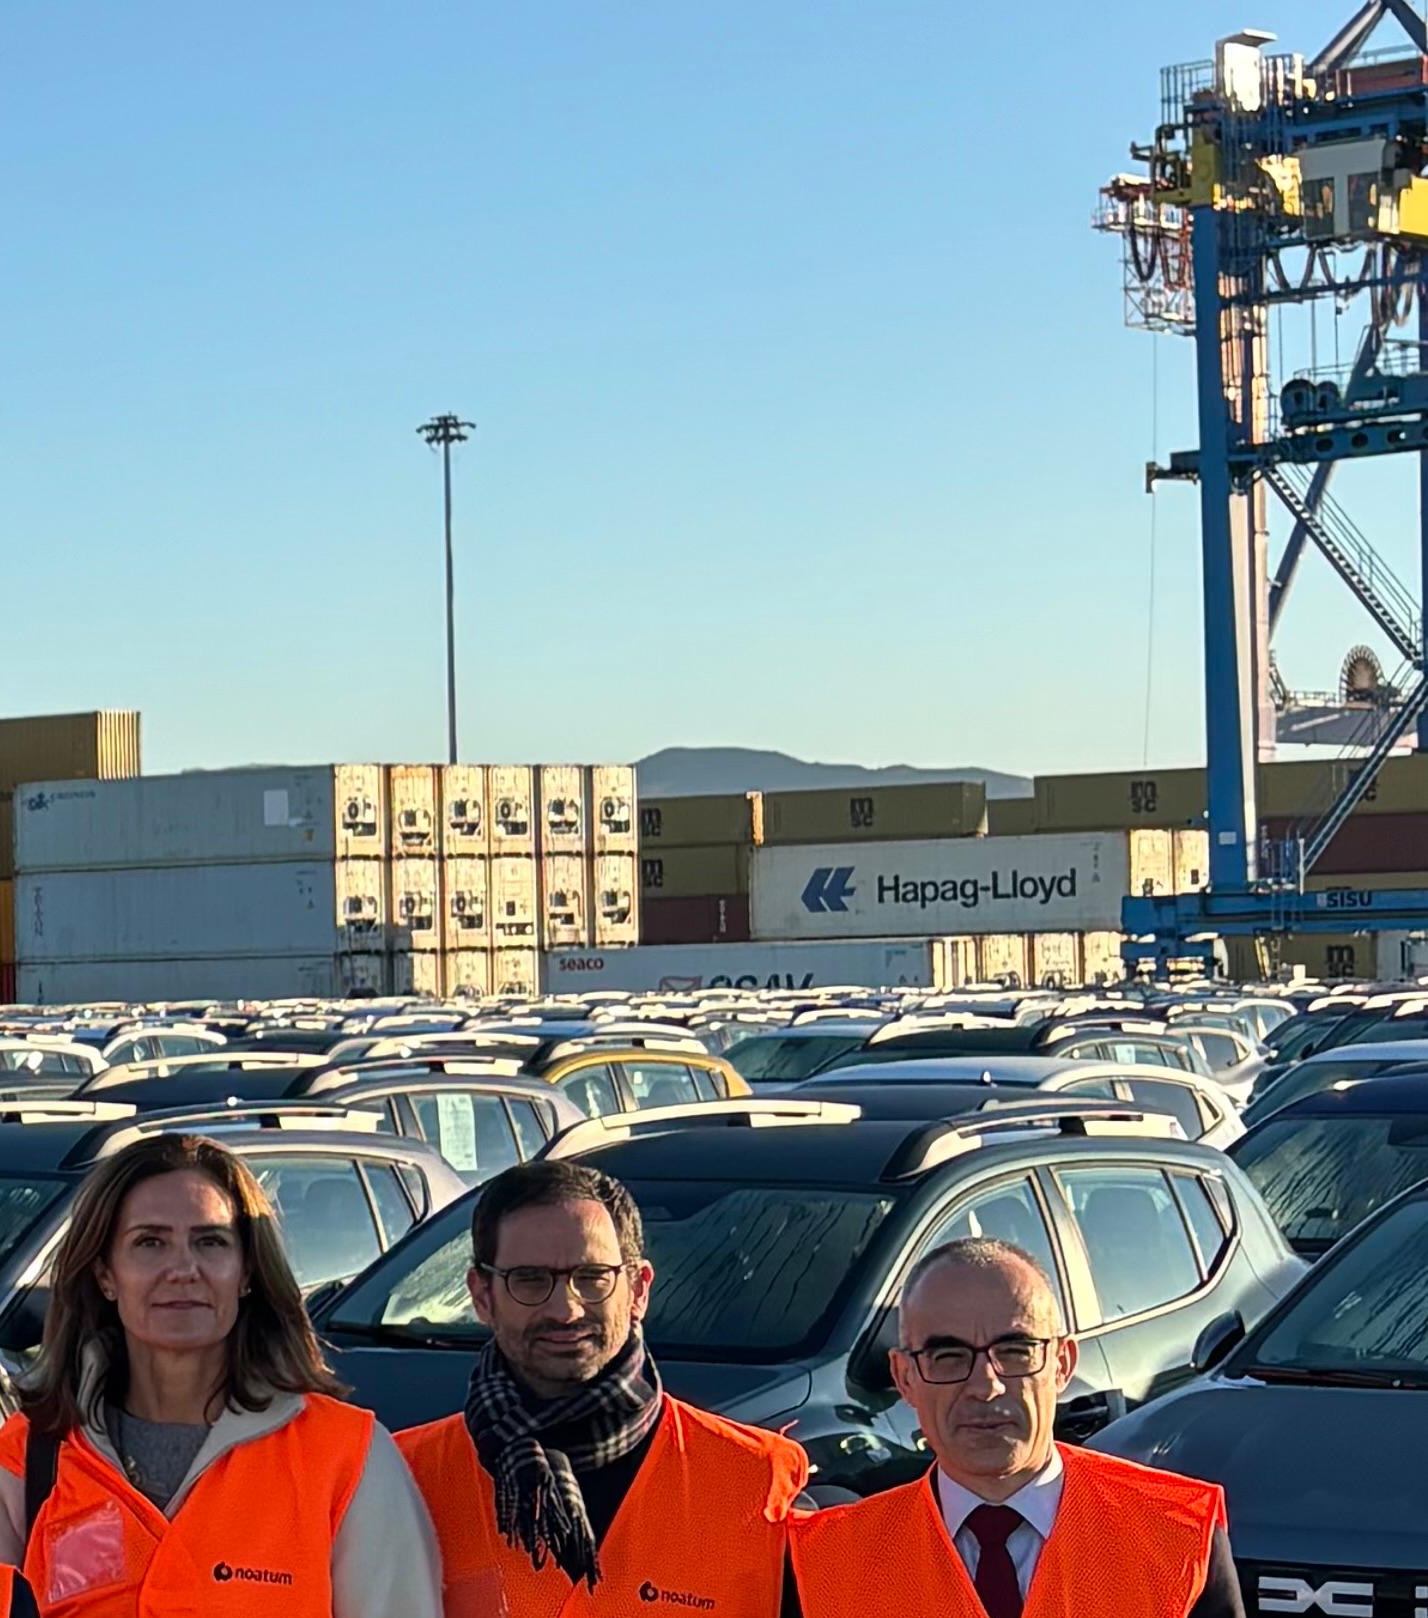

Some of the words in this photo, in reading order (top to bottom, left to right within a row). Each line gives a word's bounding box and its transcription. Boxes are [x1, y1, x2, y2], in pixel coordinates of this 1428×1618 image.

[877, 868, 1076, 908] Hapag-Lloyd
[1326, 892, 1372, 908] SISU
[559, 956, 604, 972] seaco
[235, 1567, 293, 1586] noatum
[661, 1590, 715, 1611] noatum
